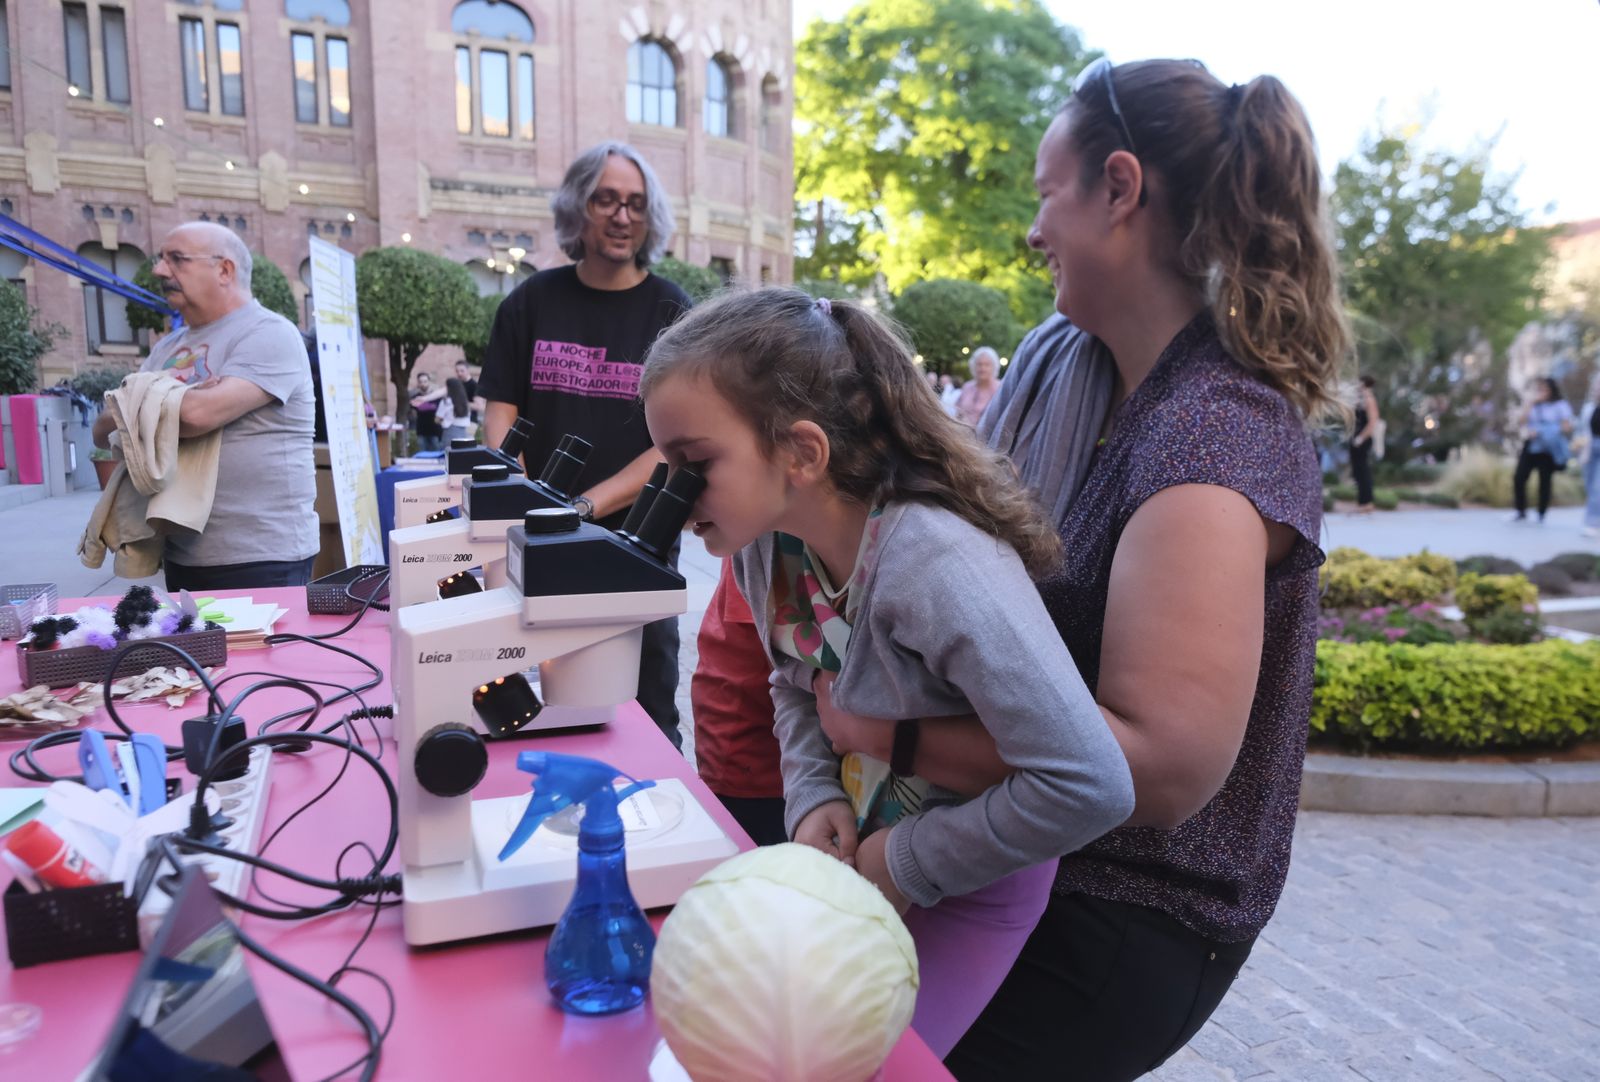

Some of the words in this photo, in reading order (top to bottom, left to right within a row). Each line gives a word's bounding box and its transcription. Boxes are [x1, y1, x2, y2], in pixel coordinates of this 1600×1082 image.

[537, 343, 553, 353] LA
[560, 345, 602, 360] NOCHE
[535, 356, 592, 374] EUROPEA
[597, 364, 611, 375] DE
[402, 554, 425, 563] Leica
[453, 553, 473, 562] 2000
[418, 651, 453, 664] Leica
[496, 646, 526, 660] 2000
